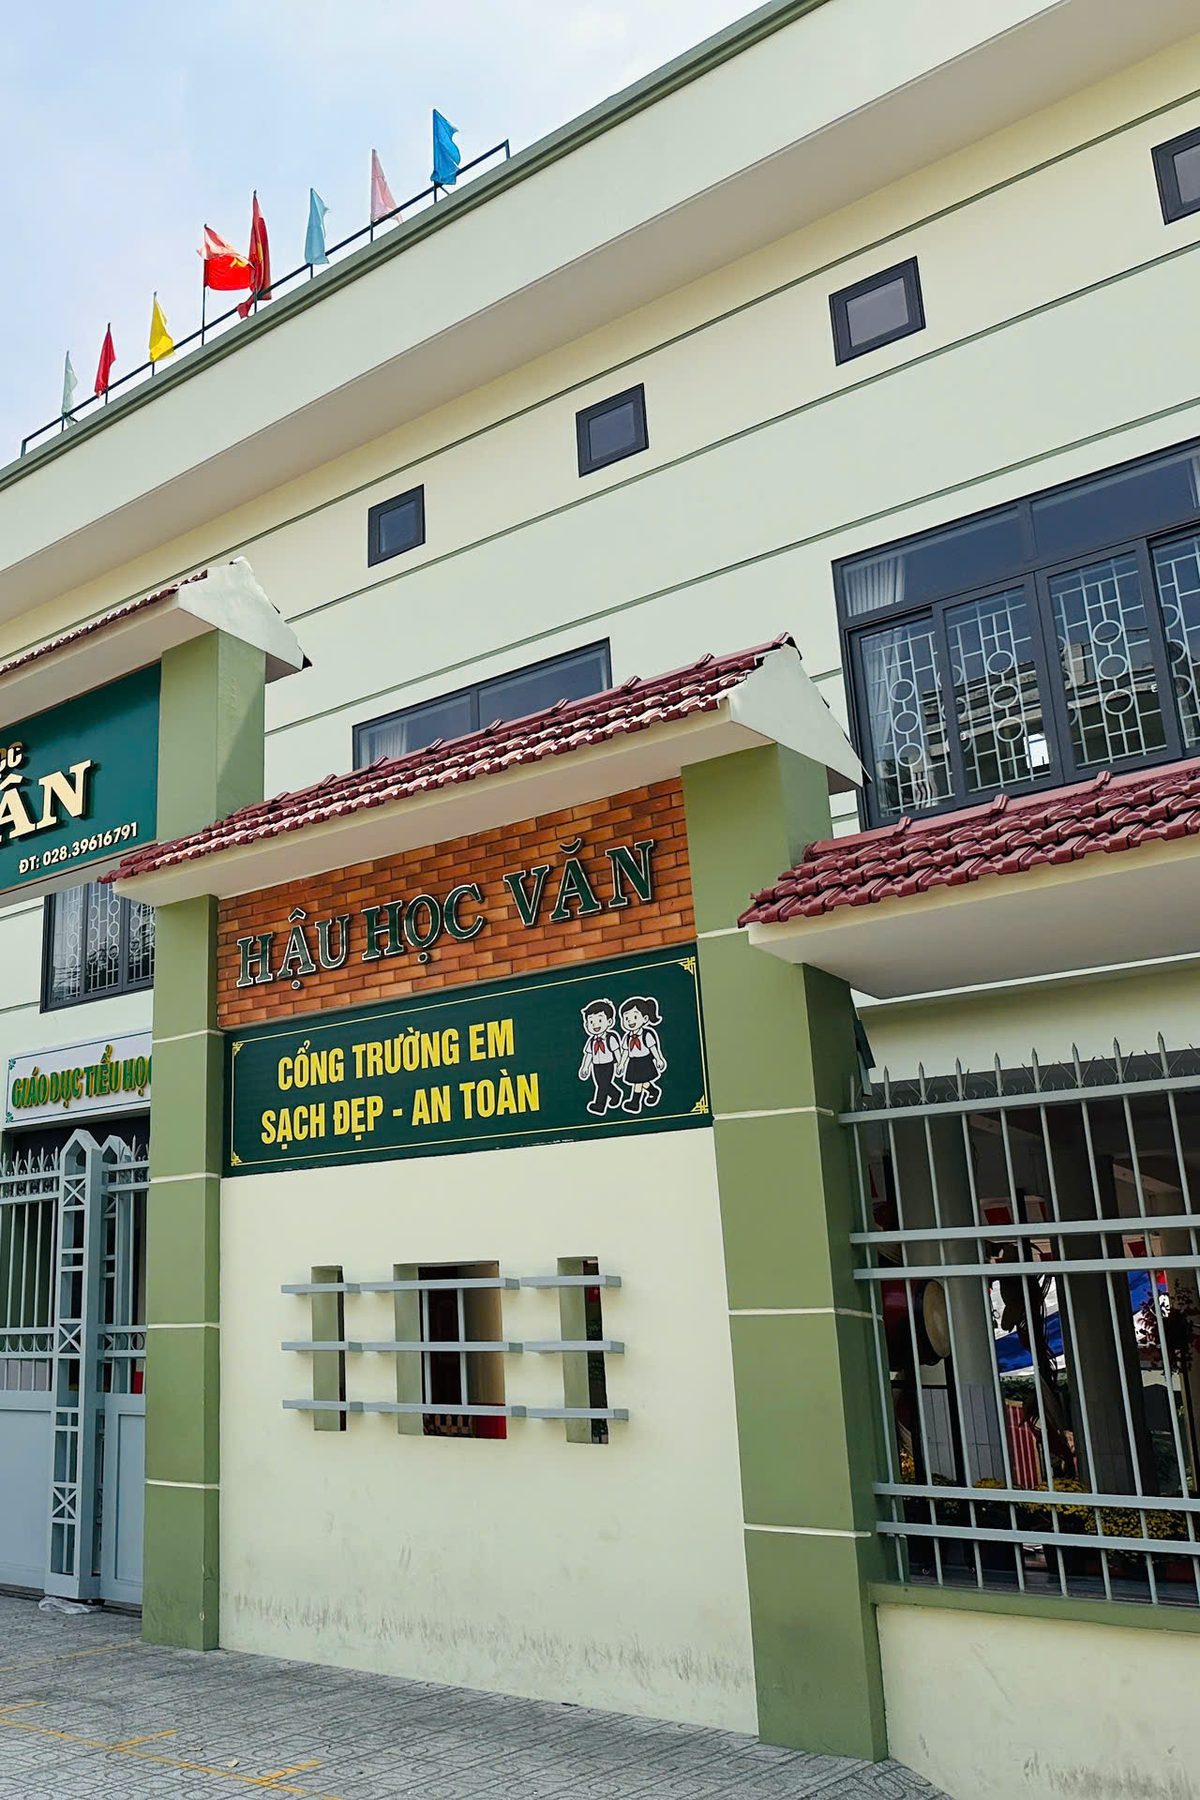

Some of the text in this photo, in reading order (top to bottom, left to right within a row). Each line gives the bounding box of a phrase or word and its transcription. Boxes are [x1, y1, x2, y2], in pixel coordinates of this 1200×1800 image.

[19, 822, 137, 874] ĐT: 028.39616791
[236, 839, 656, 989] HẬU HỌC VĂN
[12, 1044, 152, 1109] GIÁO DỤC TIỂU HỌ
[277, 1018, 515, 1092] CỔNG TRƯỜNG EM
[261, 1103, 327, 1150] SẠCH
[333, 1096, 384, 1141] ĐẸP
[411, 1086, 451, 1126] AN
[460, 1069, 540, 1117] TOÀN
